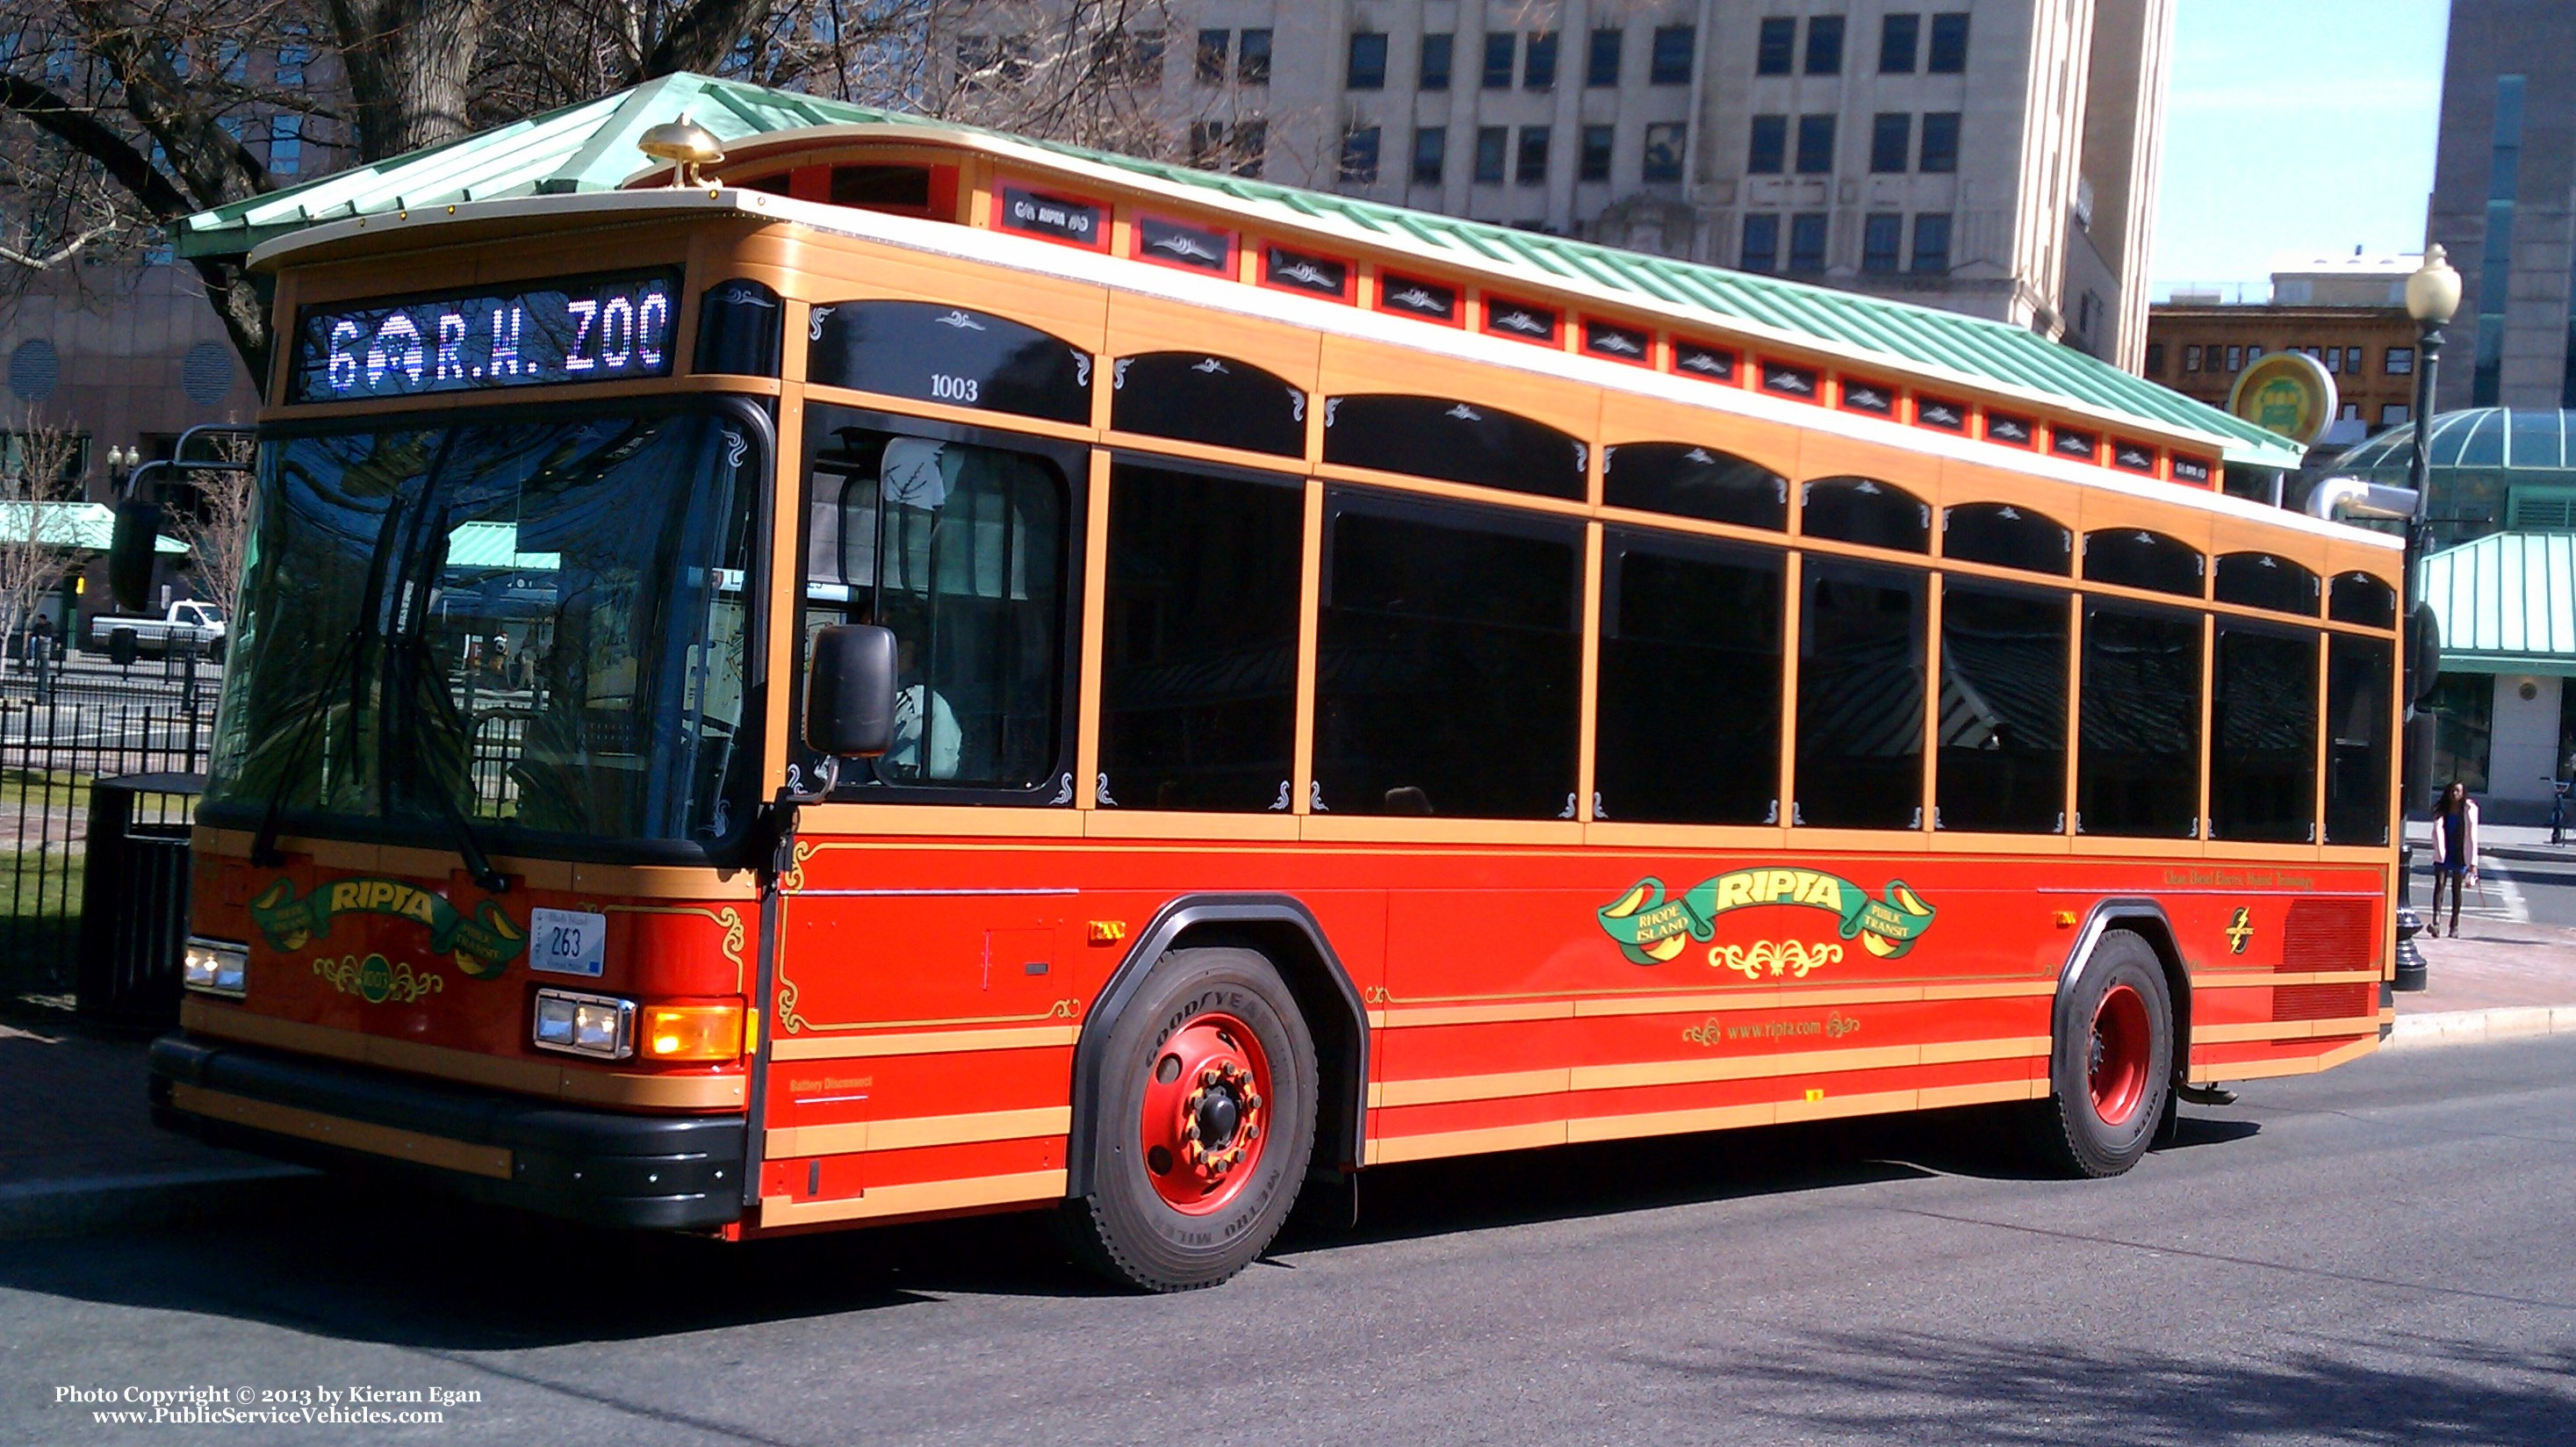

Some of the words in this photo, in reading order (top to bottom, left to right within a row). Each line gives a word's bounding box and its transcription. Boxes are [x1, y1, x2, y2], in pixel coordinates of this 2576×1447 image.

[328, 320, 357, 391] 6
[931, 373, 978, 402] 1003
[331, 881, 434, 925] RIPTA
[1716, 870, 1842, 911] RIPTA
[1638, 904, 1679, 928] RHODE
[1865, 914, 1910, 938] TRANSIT
[1872, 905, 1902, 925] PUBLIC
[551, 926, 581, 957] 263
[1637, 917, 1688, 941] ISLAND
[1728, 1020, 1821, 1043] www.ripta.com
